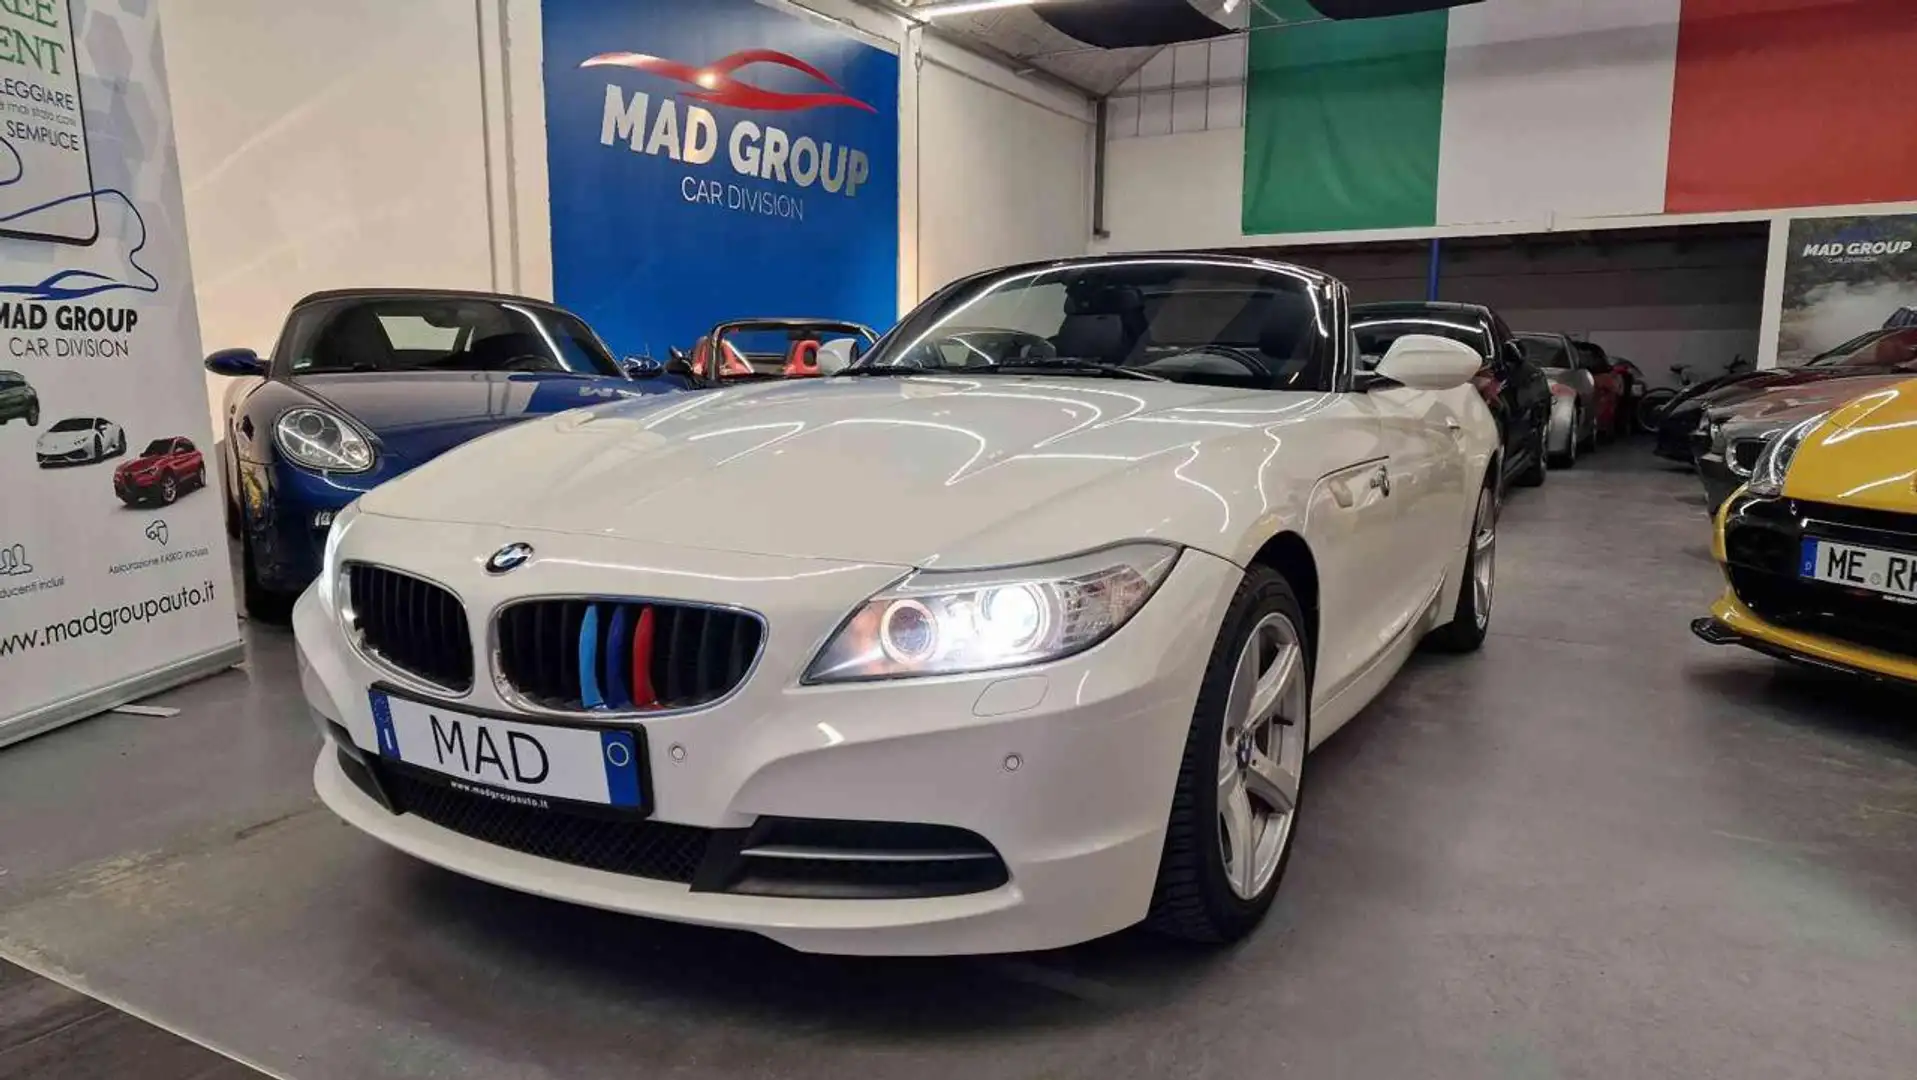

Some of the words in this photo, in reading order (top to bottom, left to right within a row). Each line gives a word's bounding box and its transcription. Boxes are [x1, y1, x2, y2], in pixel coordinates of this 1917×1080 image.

[6, 120, 79, 151] SEMPLICE
[600, 84, 718, 164] MAD
[729, 120, 869, 197] GROUP
[681, 176, 723, 205] CAR
[727, 184, 803, 221] DIVISION
[1803, 242, 1844, 257] MAD
[1846, 240, 1913, 255] GROUP
[55, 305, 138, 332] GROUP
[9, 336, 50, 357] CAR
[55, 338, 129, 357] DIVISION
[1827, 546, 1867, 584] ME
[429, 714, 550, 785] MAD
[450, 780, 550, 810] www.madgroupauto.it
